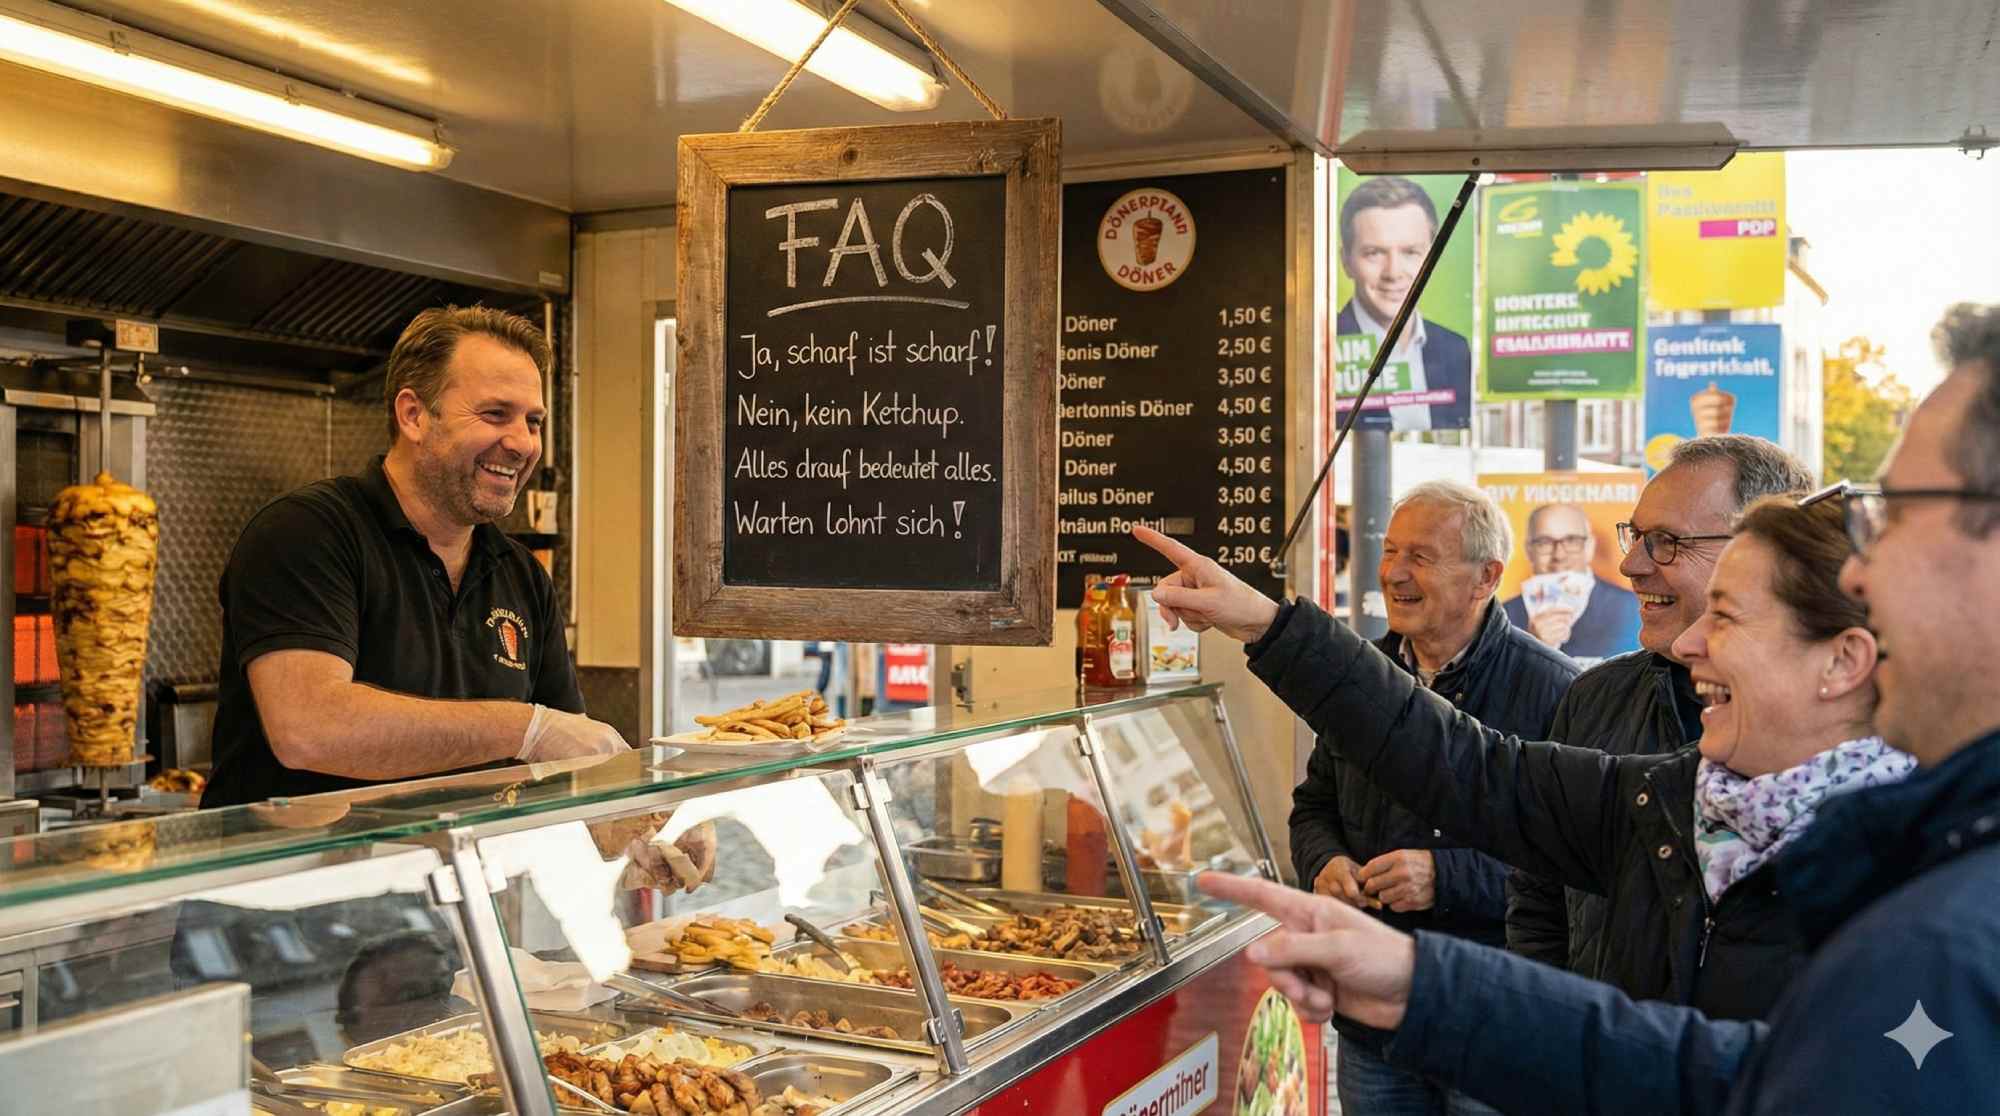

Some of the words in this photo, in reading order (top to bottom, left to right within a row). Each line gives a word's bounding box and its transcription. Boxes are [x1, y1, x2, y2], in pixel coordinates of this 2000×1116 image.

[765, 193, 957, 289] FAQ
[1117, 262, 1177, 284] DÖNER
[1065, 315, 1118, 333] Döner
[738, 333, 780, 380] Ja,
[787, 330, 859, 376] scharf
[869, 329, 897, 364] ist
[905, 324, 998, 376] scharf!
[1105, 342, 1159, 360] Döner
[737, 393, 798, 433] Nein,
[804, 392, 851, 426] kein
[862, 391, 965, 439] Ketchup.
[1139, 400, 1194, 417] Döner
[1061, 430, 1114, 448] Döner
[733, 447, 788, 479] Alles
[795, 447, 852, 490] drauf
[859, 447, 940, 480] bedeutet
[943, 451, 998, 483] alles.
[1064, 459, 1117, 476] Döner
[1102, 487, 1155, 505] Döner
[733, 500, 815, 536] Warten
[825, 501, 887, 536] lohnt
